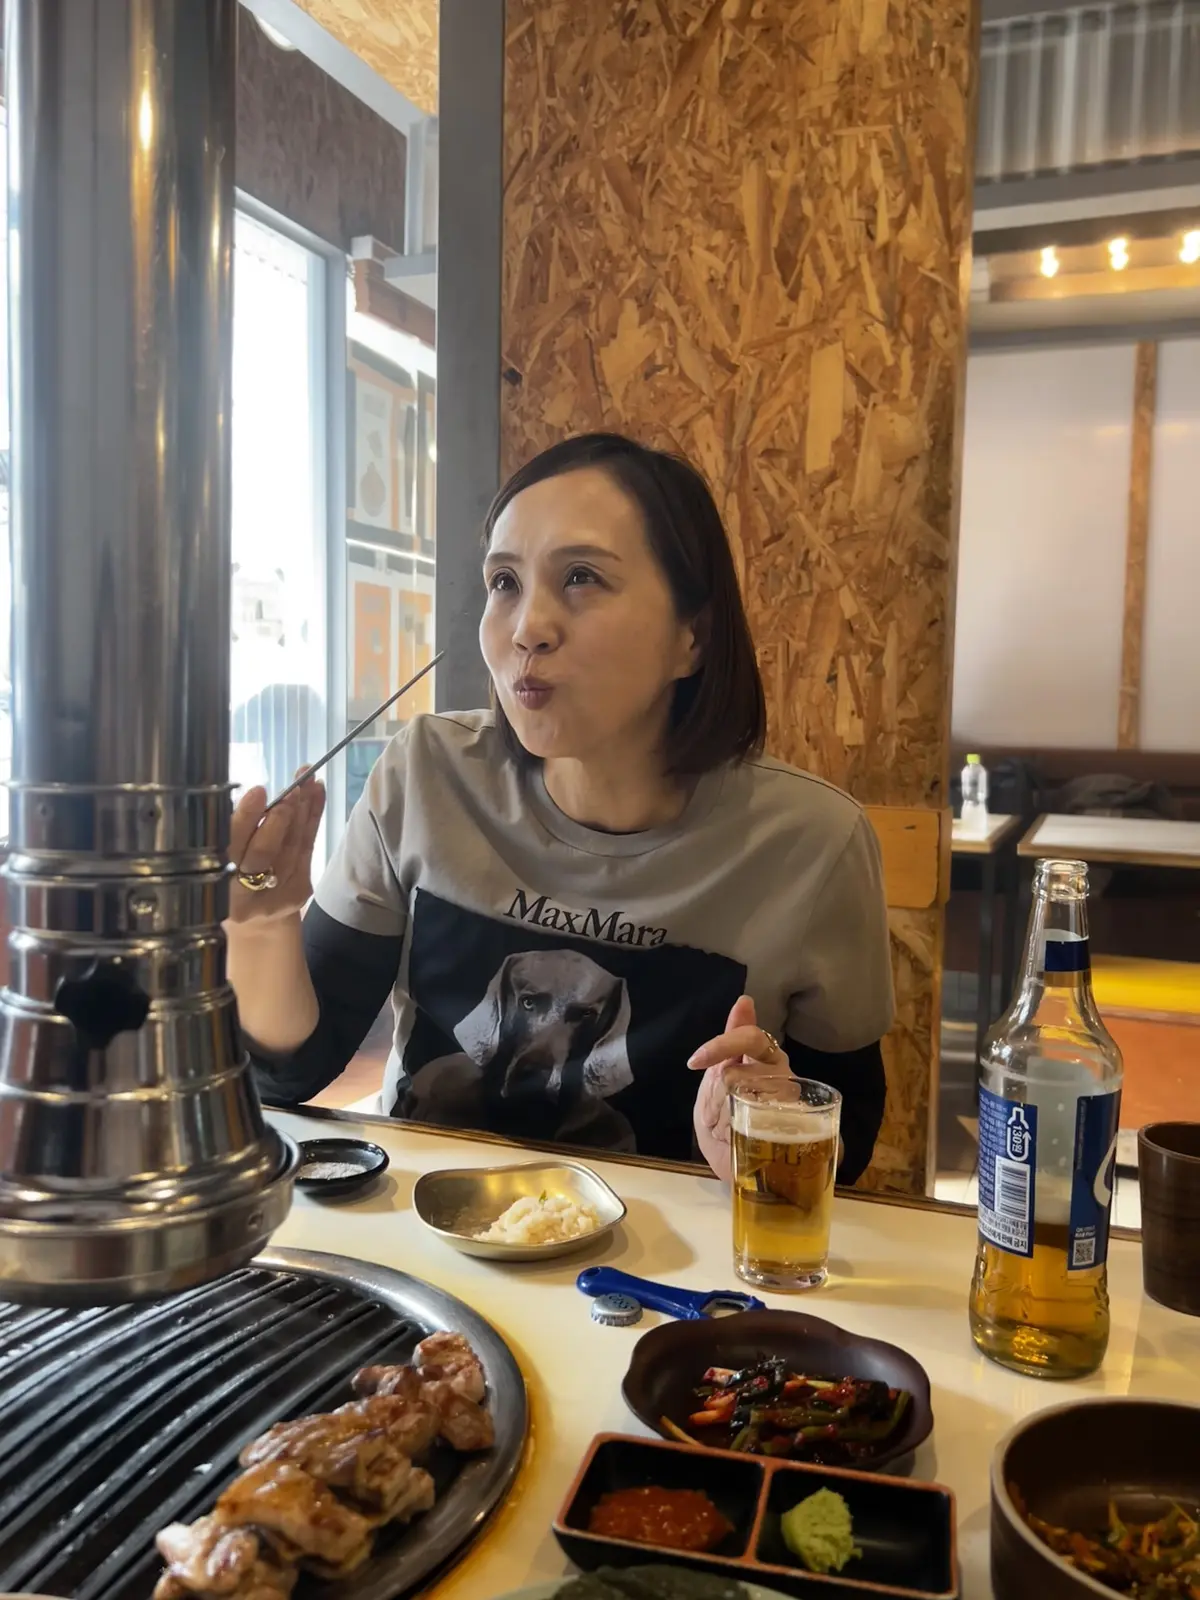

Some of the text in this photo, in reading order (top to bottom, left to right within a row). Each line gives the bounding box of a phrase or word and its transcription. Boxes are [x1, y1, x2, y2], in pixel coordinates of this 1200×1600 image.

[503, 888, 668, 946] MaxMara
[1011, 1125, 1023, 1153] 130원
[1014, 1237, 1027, 1250] 금지
